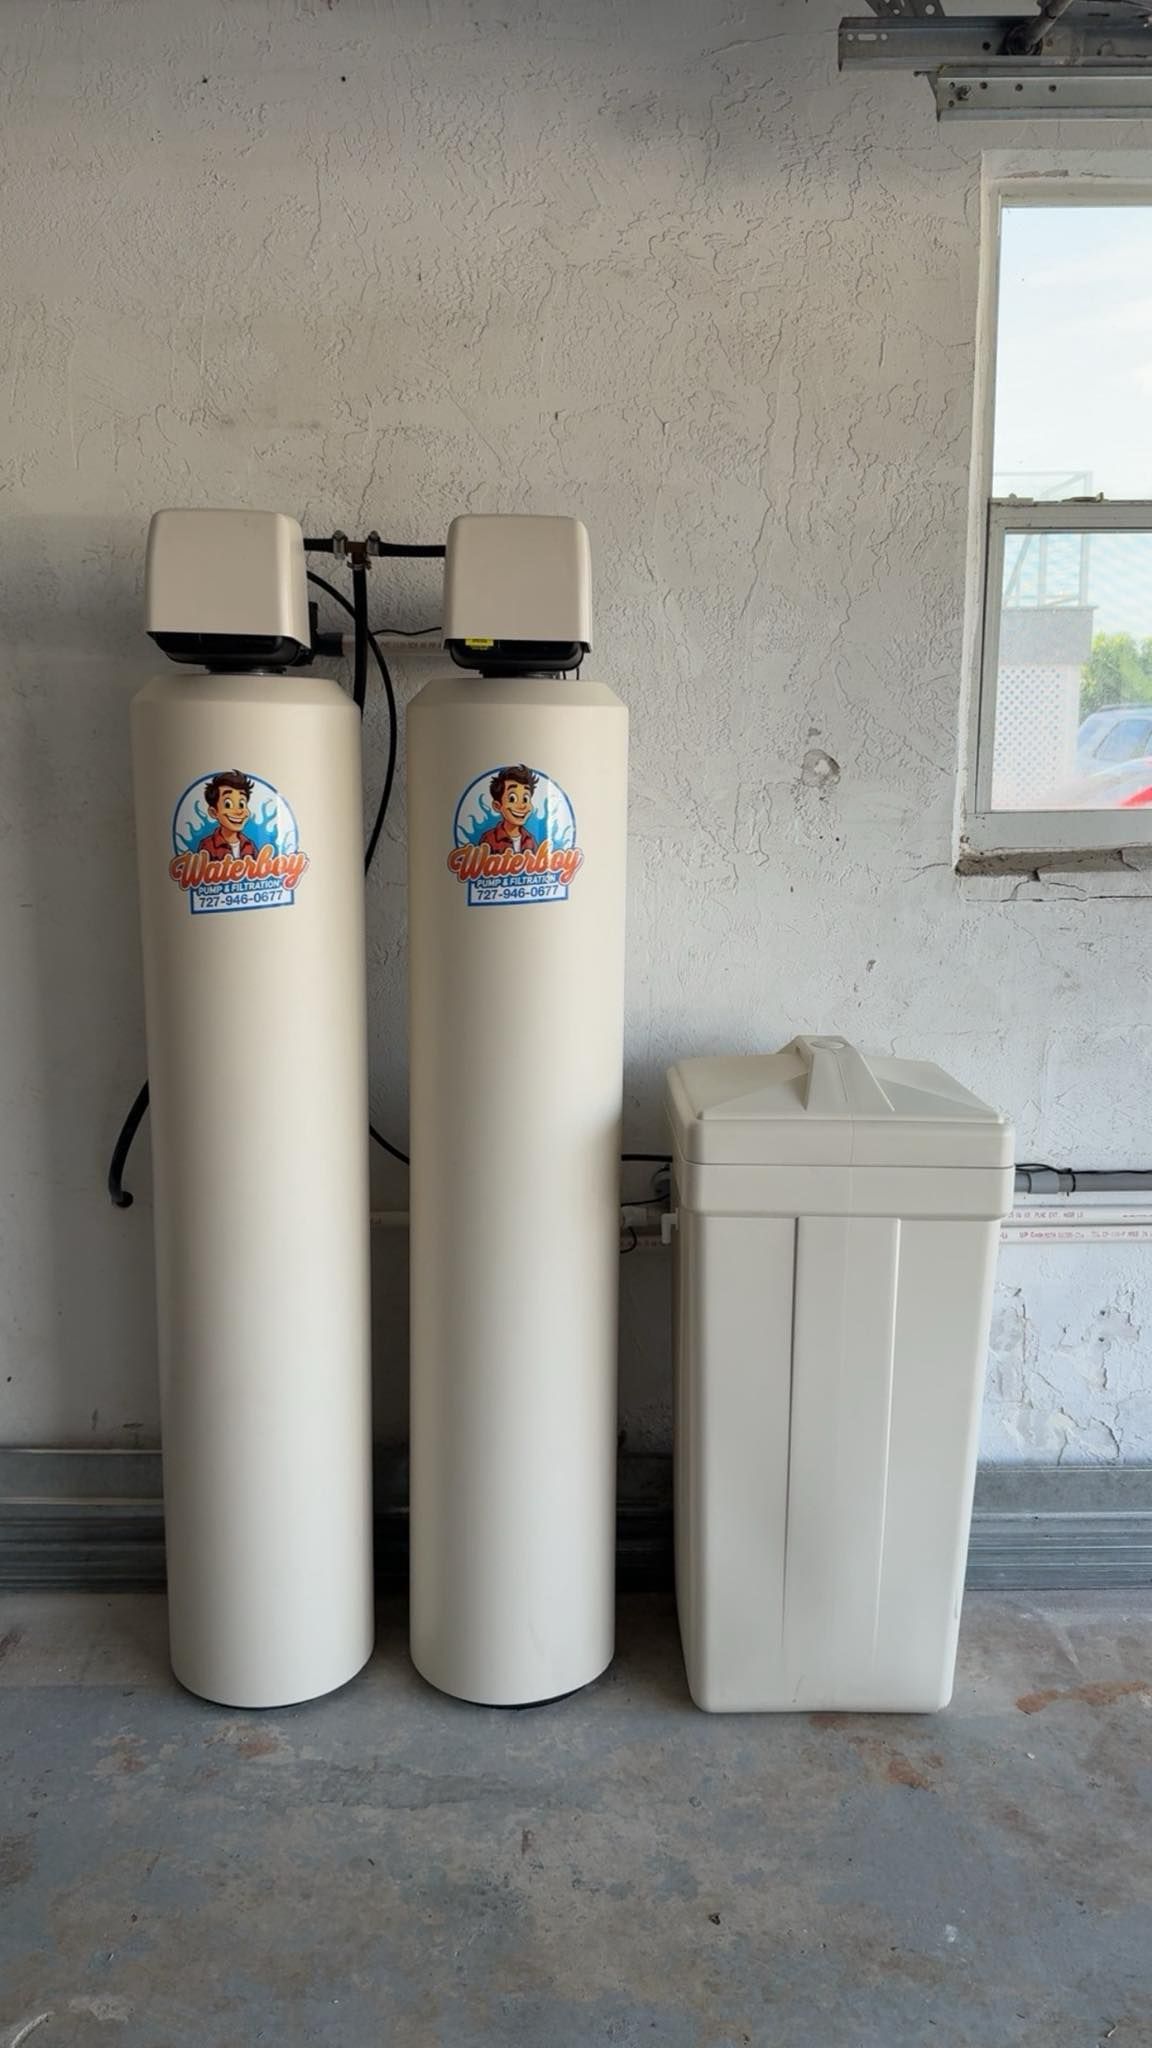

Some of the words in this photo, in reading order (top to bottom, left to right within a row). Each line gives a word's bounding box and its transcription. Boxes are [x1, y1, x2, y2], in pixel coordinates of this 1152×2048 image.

[170, 845, 307, 890] Waterboy
[449, 841, 581, 885] Waterboy
[199, 885, 222, 896] PUMP
[223, 885, 230, 894] &
[231, 880, 280, 893] FILTRATION
[477, 878, 501, 888] PUMP
[502, 878, 509, 887] &
[200, 890, 283, 908] 727-946-0677
[478, 885, 559, 900] 727-946-0677
